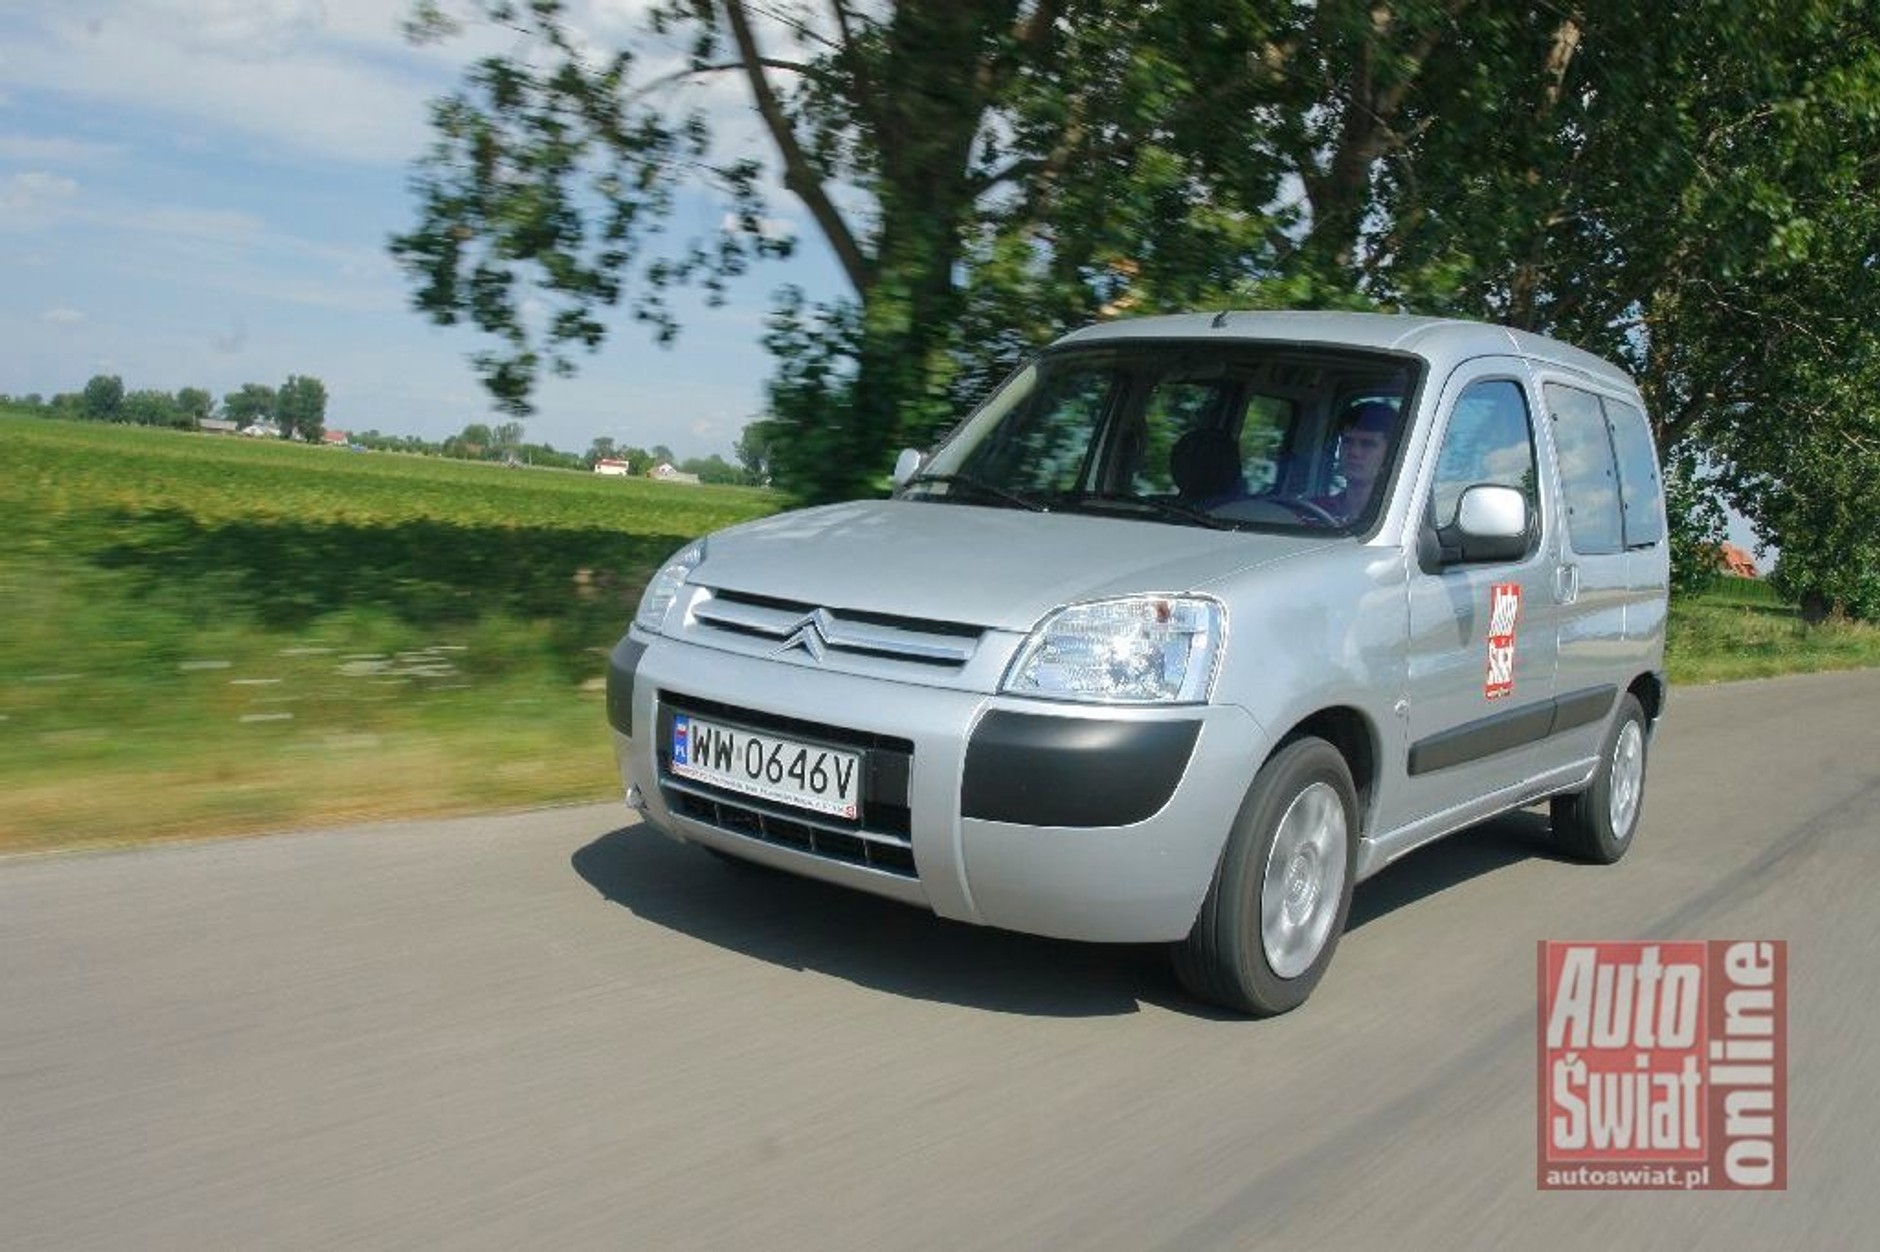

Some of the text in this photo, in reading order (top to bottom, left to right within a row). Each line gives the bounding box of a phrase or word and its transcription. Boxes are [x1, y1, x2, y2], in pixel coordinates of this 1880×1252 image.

[674, 744, 686, 757] PL
[692, 725, 734, 772] WW
[745, 738, 854, 799] 0646V
